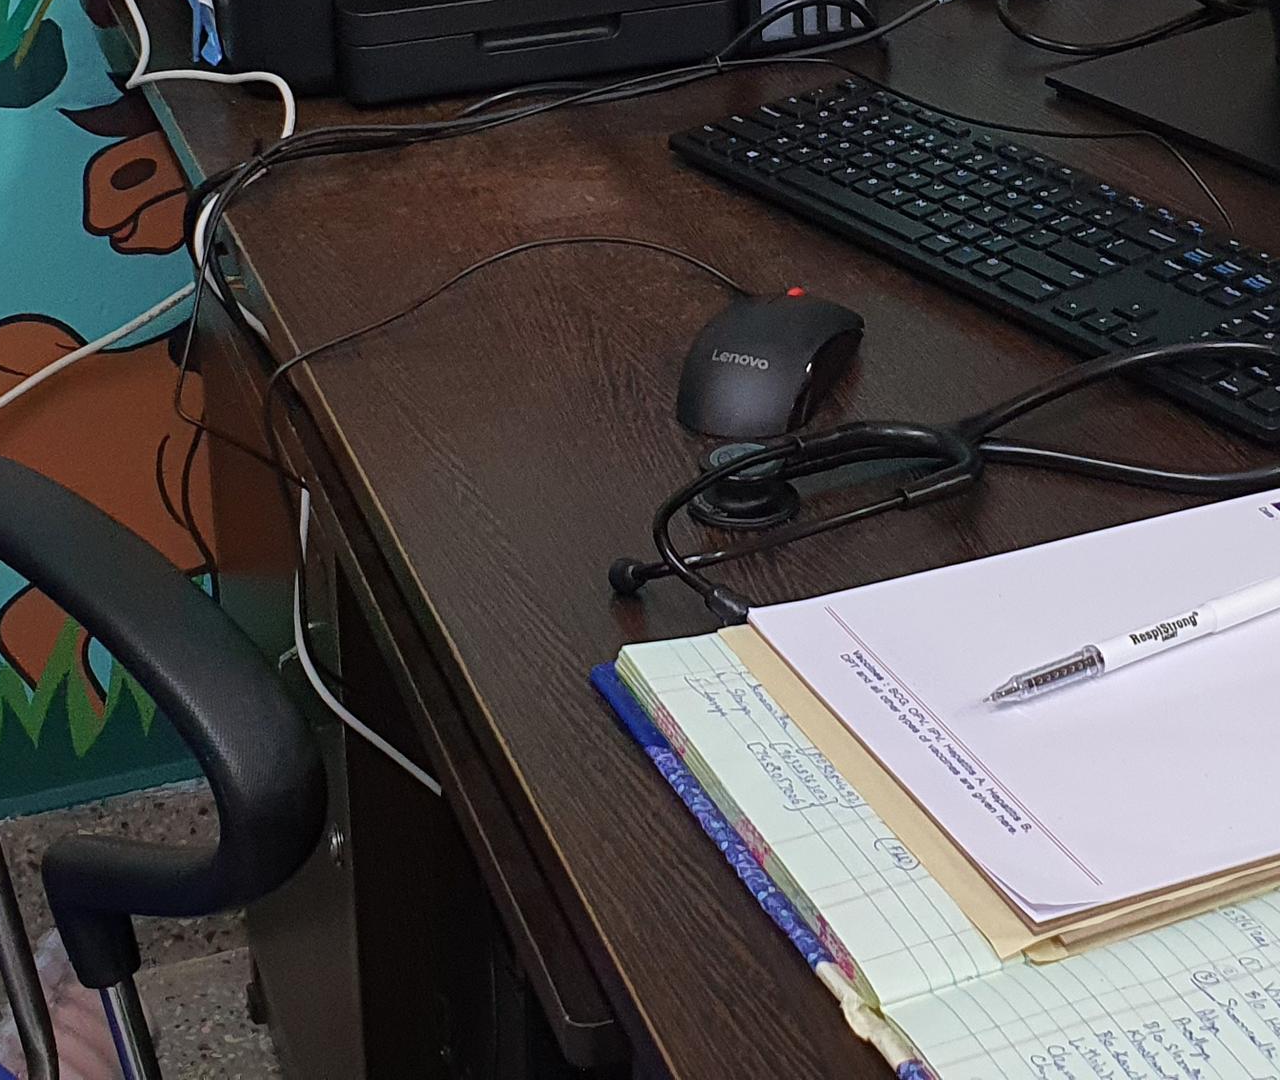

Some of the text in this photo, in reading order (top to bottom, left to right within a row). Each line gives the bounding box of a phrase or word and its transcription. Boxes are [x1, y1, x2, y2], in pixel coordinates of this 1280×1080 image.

[711, 349, 769, 370] Lenovo
[840, 654, 860, 668] DPT
[856, 671, 873, 684] and
[880, 695, 901, 713] other
[898, 714, 920, 733] types
[928, 744, 961, 775] vaccines
[960, 778, 975, 790] are
[972, 792, 997, 813] given
[996, 815, 1017, 835] here.
[853, 650, 884, 681] Vaccines
[944, 744, 977, 776] Hepatitis
[986, 788, 1021, 822] Hepatitis
